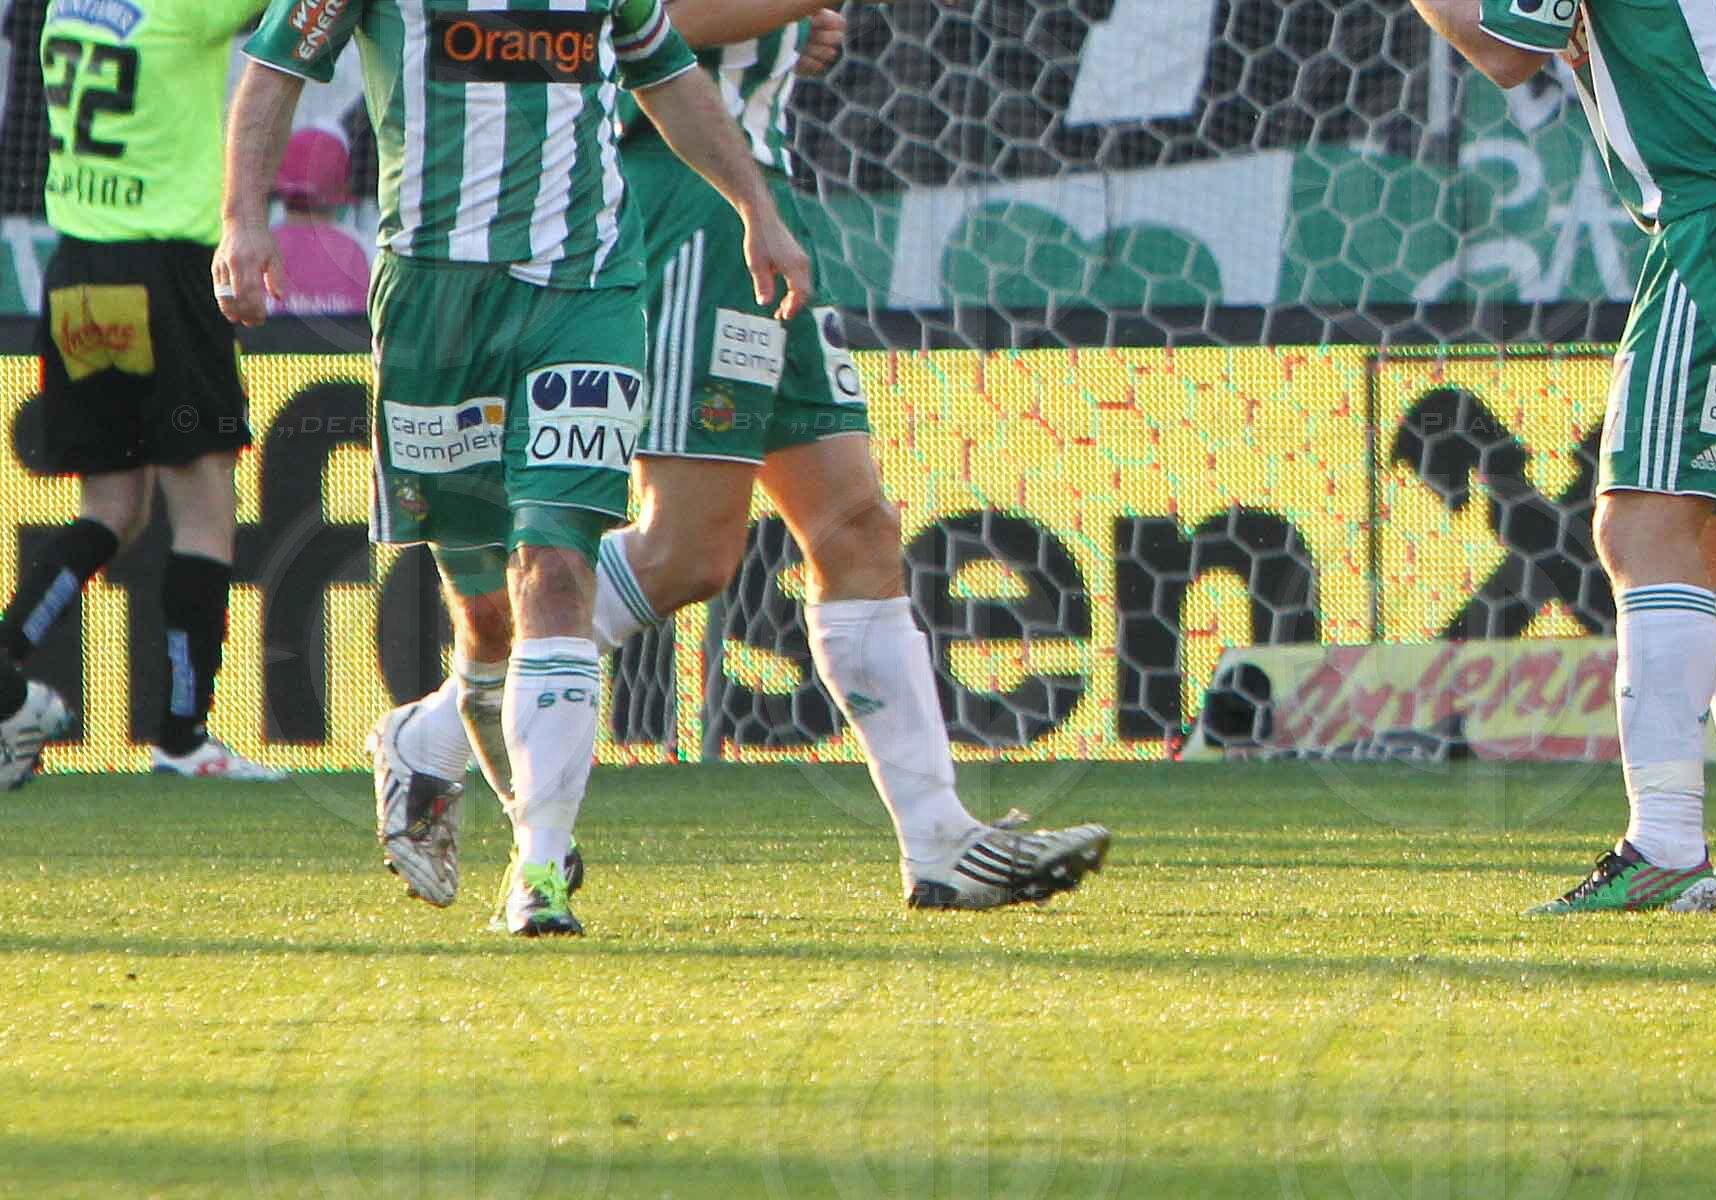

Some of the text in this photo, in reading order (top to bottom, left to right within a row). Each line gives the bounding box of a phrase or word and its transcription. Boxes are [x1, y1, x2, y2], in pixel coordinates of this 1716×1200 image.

[444, 21, 598, 73] Orange
[391, 414, 443, 437] card
[531, 424, 638, 466] OMV
[537, 686, 598, 708] SC
